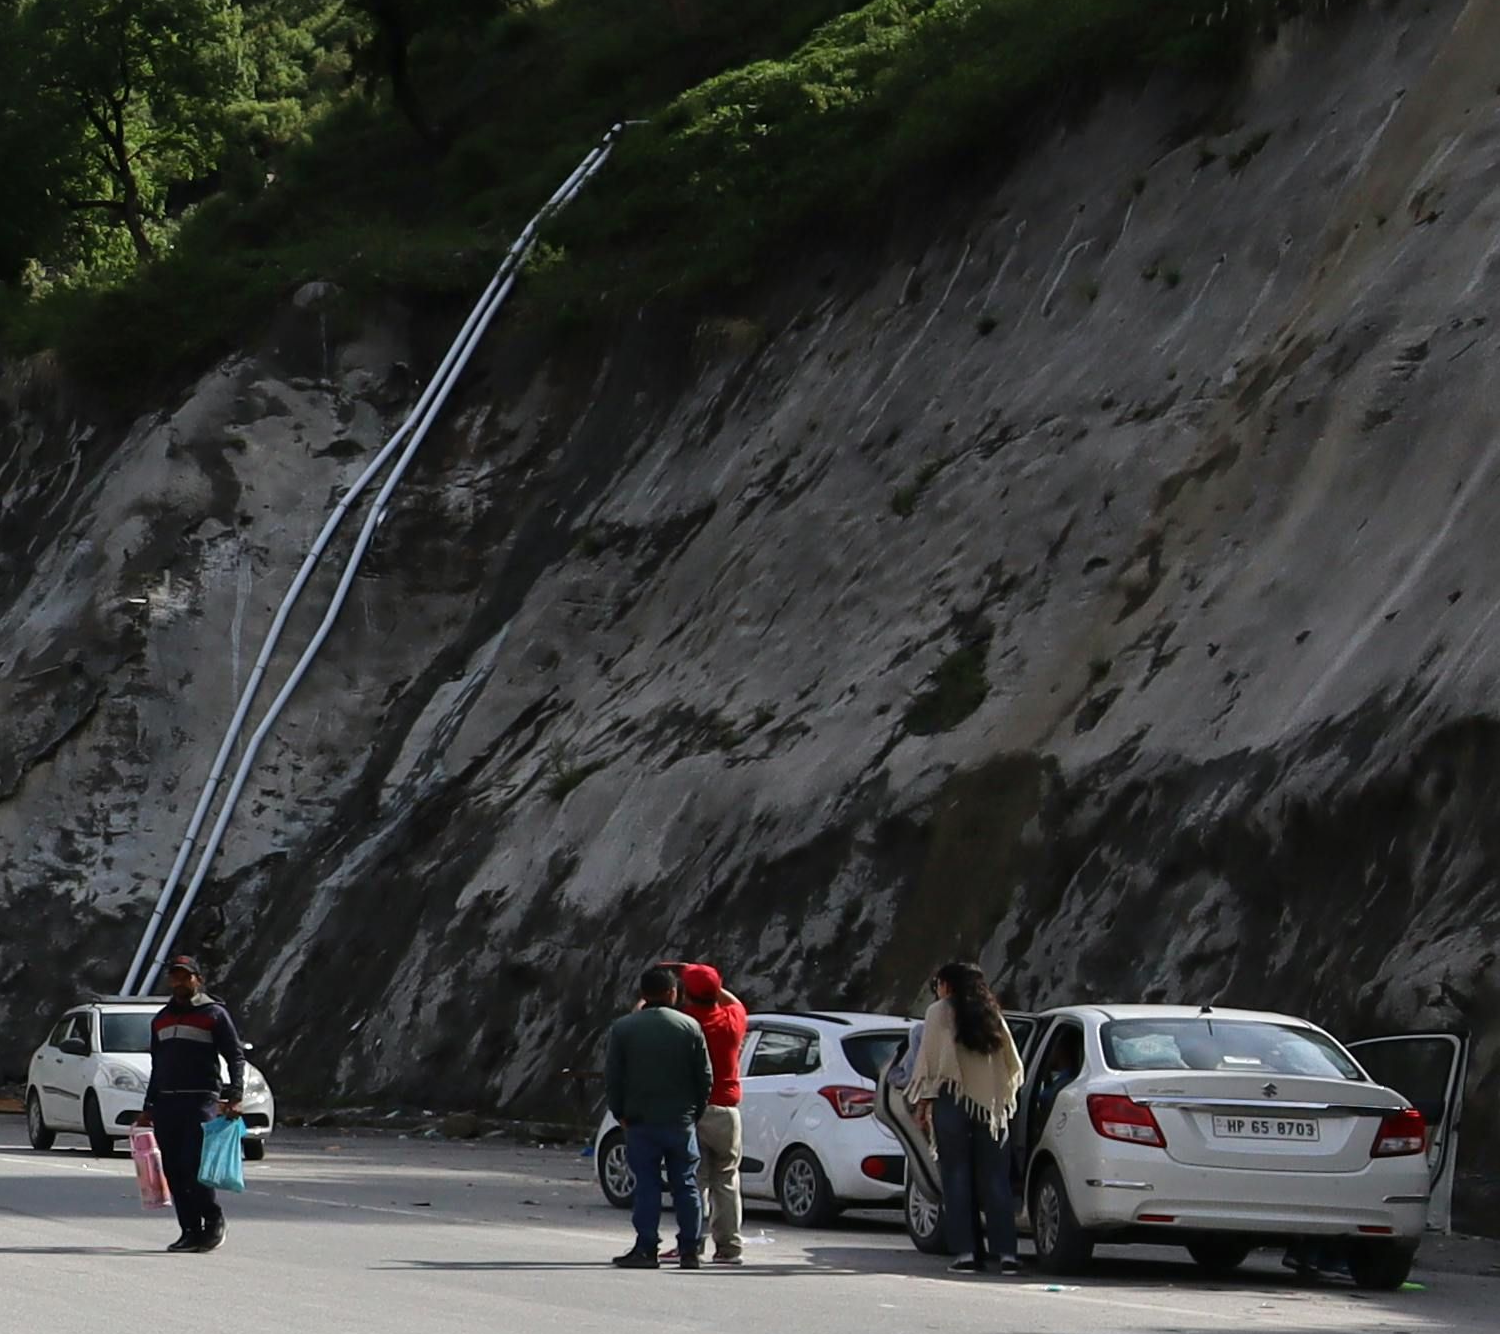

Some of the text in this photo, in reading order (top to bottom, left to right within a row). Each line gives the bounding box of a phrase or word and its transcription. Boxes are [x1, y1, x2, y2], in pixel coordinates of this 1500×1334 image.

[1227, 1119, 1314, 1136] HP 65 8703
